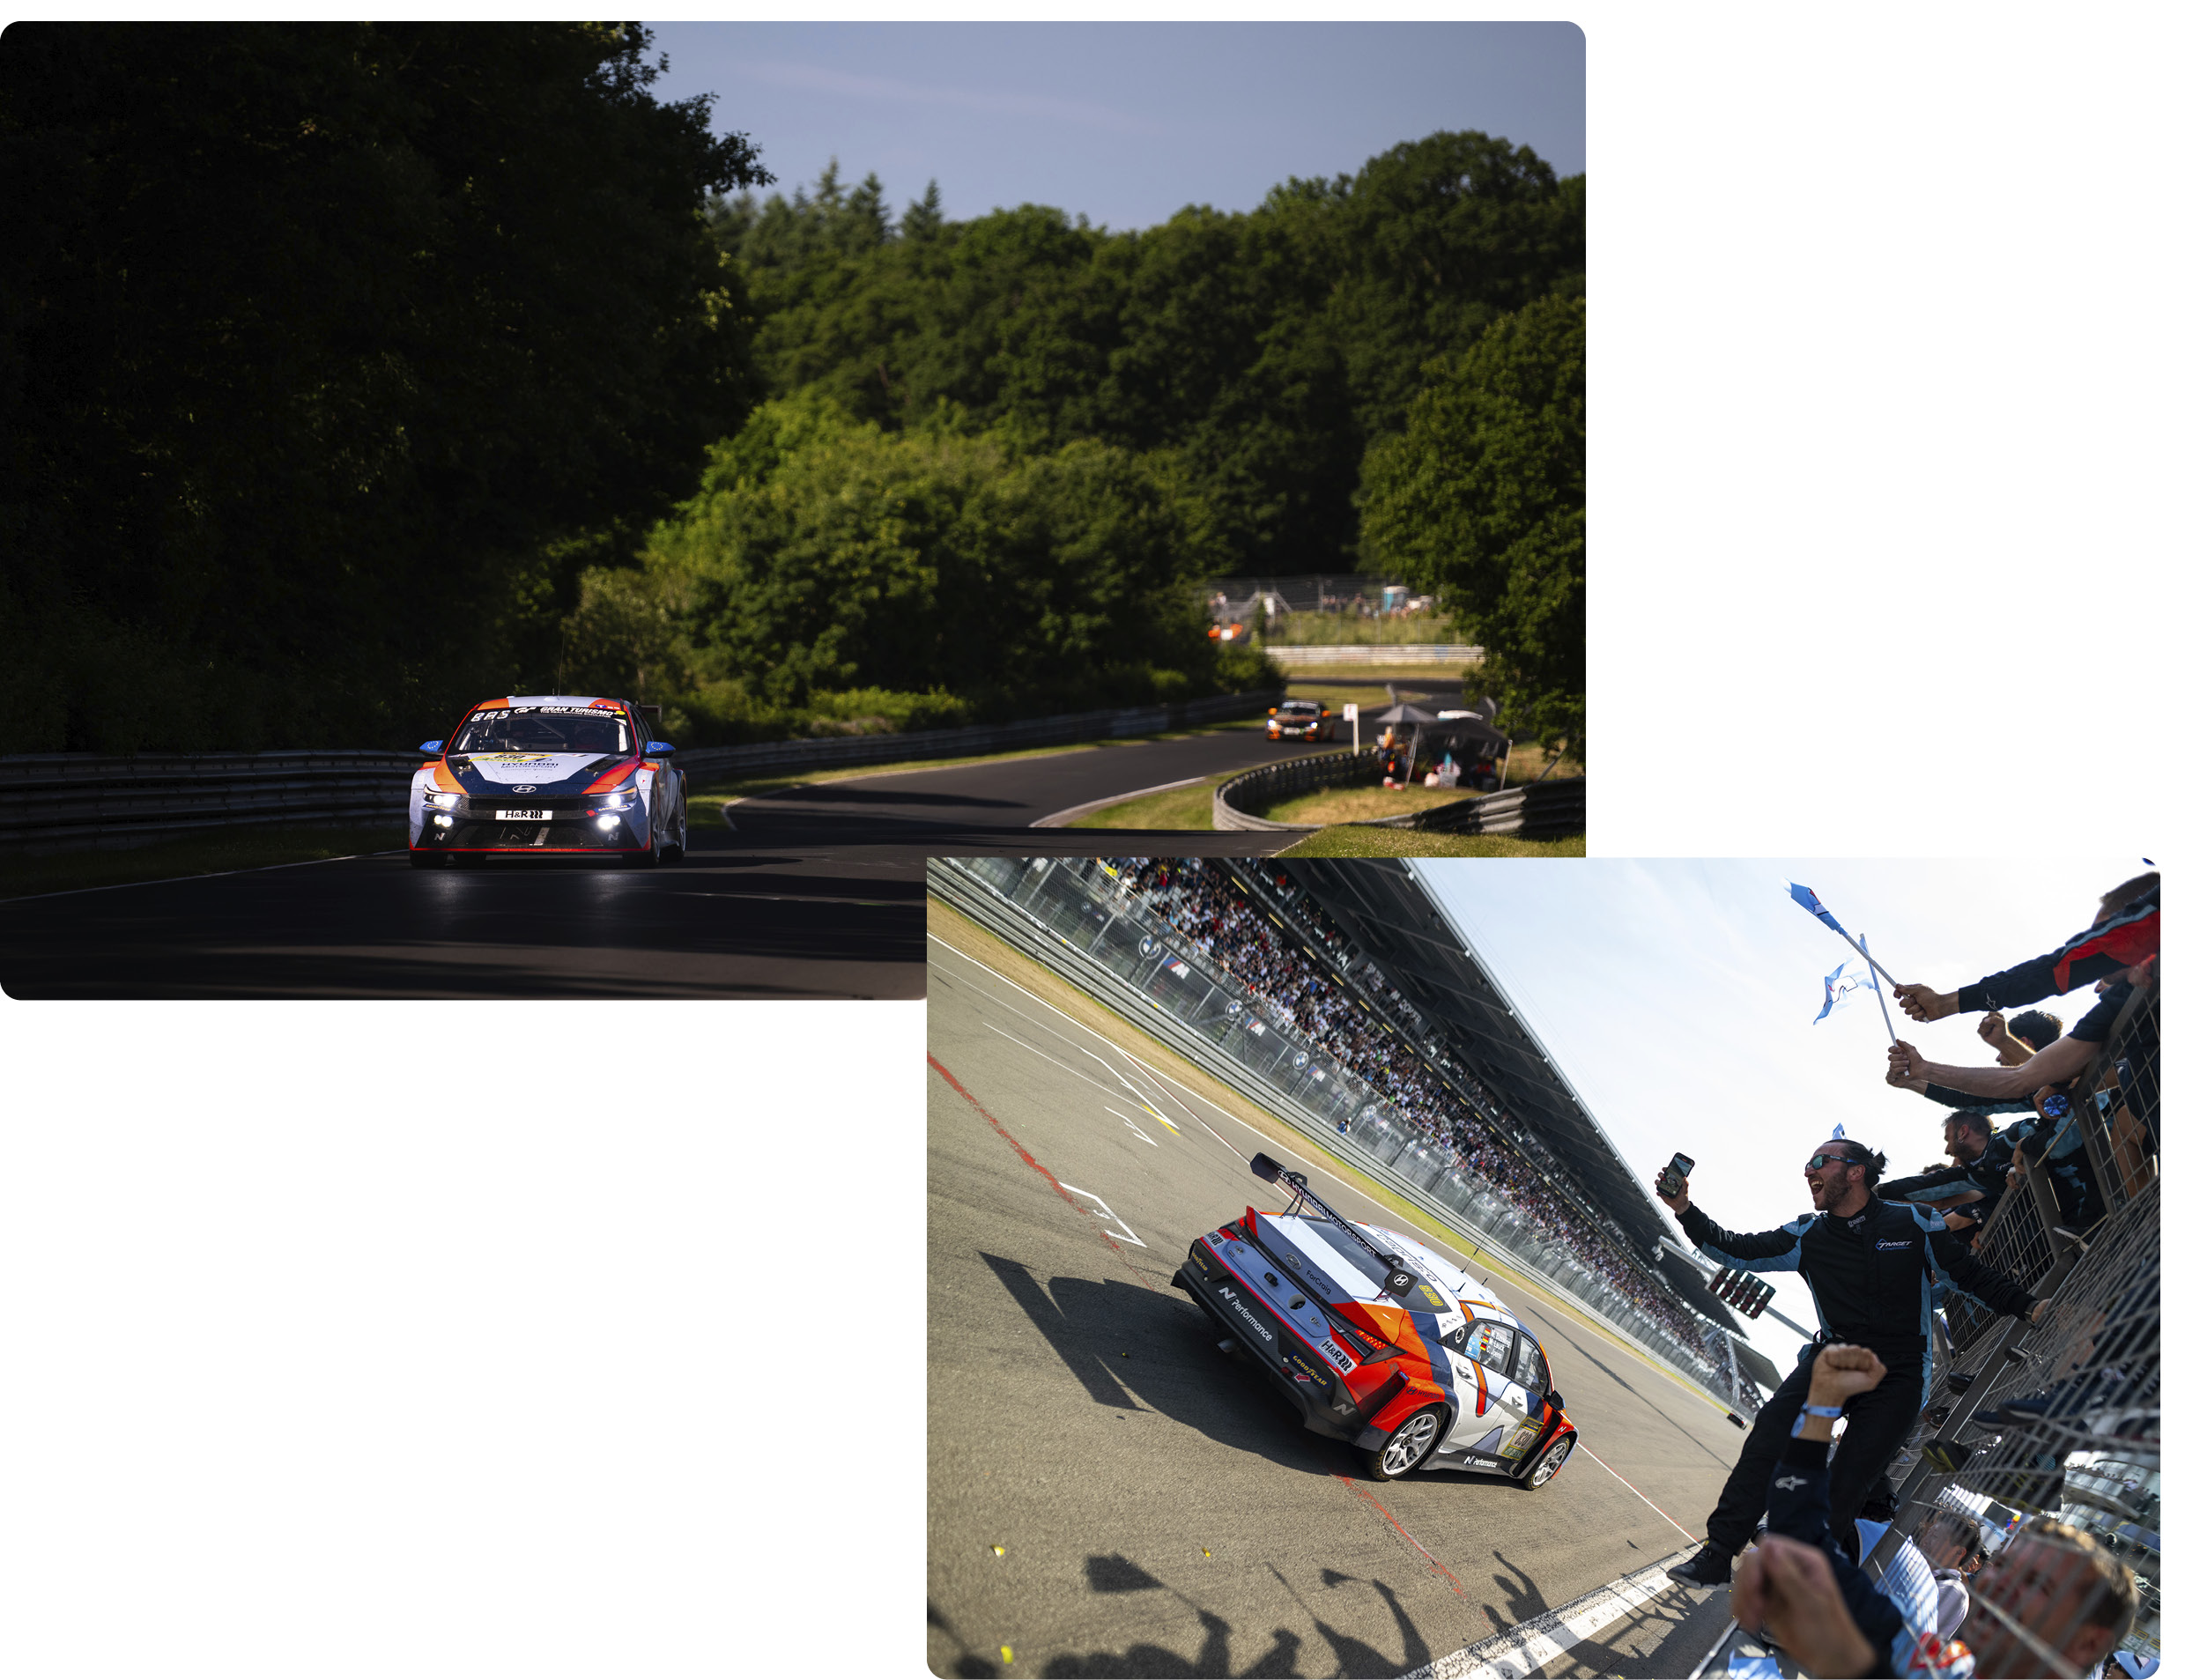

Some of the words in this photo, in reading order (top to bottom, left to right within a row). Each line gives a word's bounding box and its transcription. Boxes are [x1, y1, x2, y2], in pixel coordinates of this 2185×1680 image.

[570, 707, 614, 716] TURISMO
[505, 810, 529, 819] H&R
[1292, 1180, 1326, 1215] HYUNDAI
[1325, 1210, 1376, 1258] MOTORSPORT
[1878, 1240, 1913, 1249] TARGET
[1307, 1269, 1331, 1295] ForCraig
[1418, 1284, 1444, 1306] 830
[1232, 1299, 1272, 1342] Performance
[1322, 1340, 1343, 1362] H&R
[1292, 1355, 1328, 1386] GOODYEAR
[1417, 1389, 1441, 1400] HYUNDAI
[1514, 1430, 1534, 1447] 830
[1472, 1457, 1498, 1469] Performance
